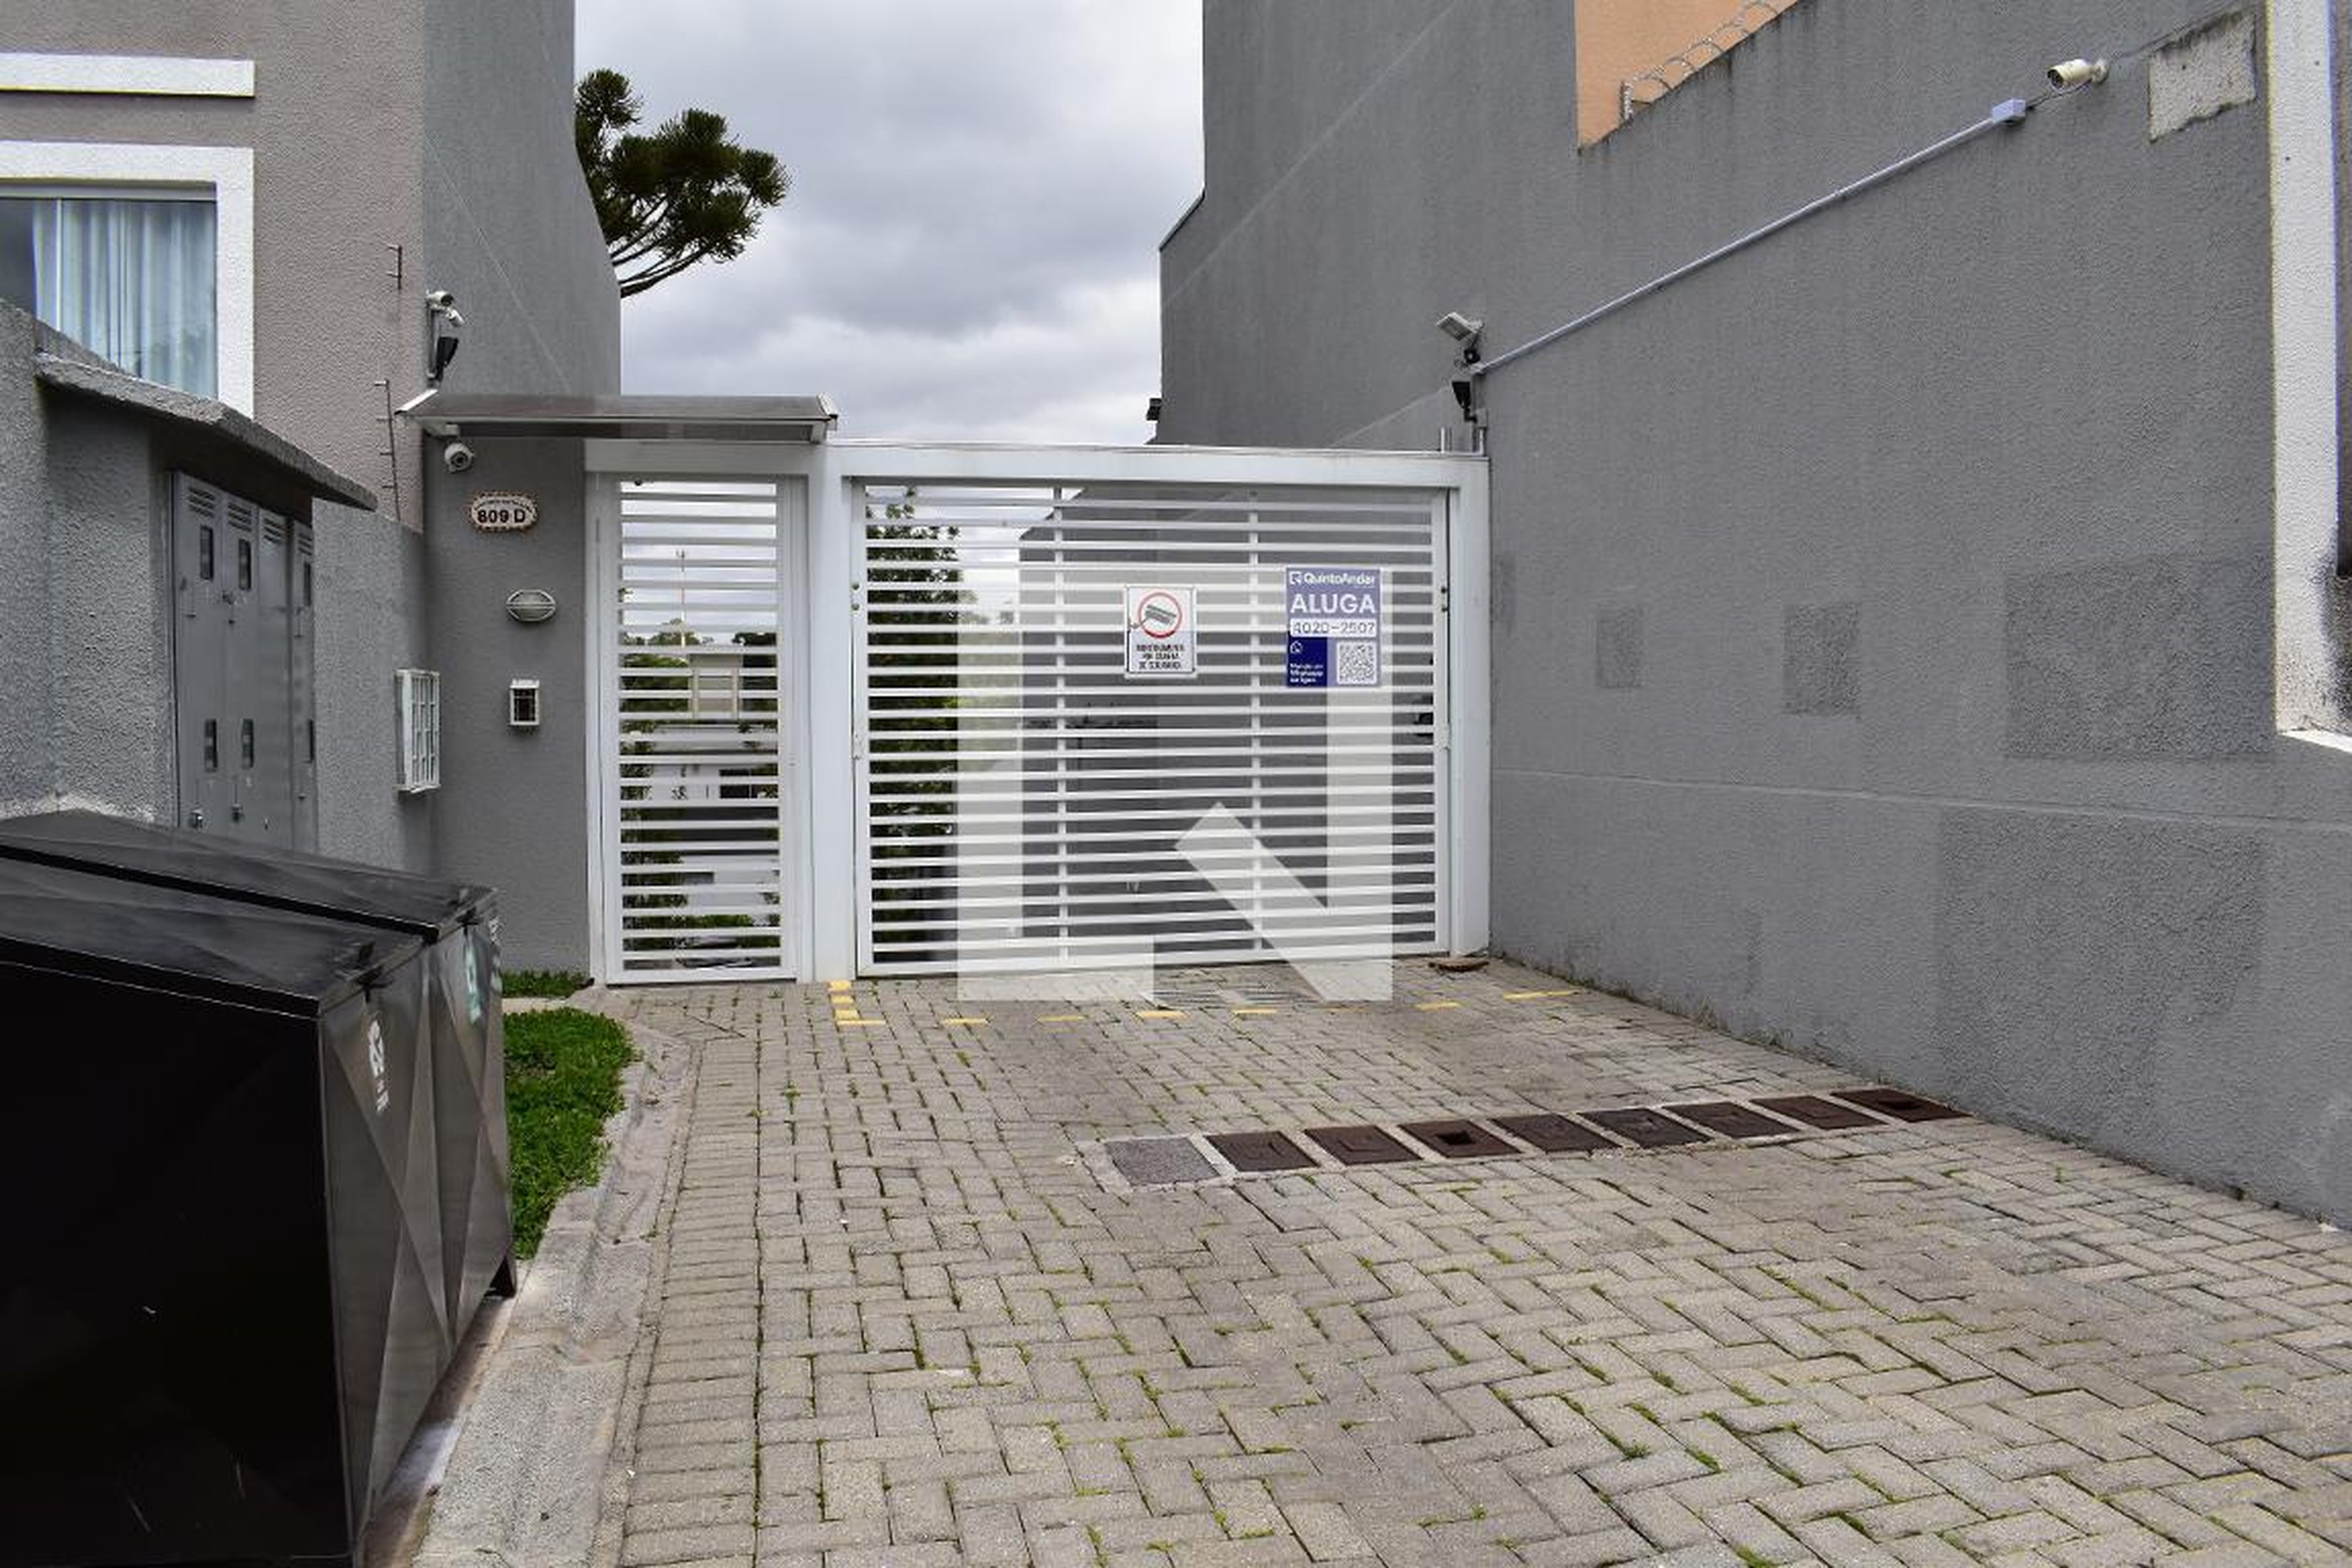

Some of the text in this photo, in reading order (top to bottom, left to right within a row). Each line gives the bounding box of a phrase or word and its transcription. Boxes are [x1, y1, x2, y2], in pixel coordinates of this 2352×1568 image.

[478, 509, 526, 523] 809 D
[1290, 594, 1376, 614] ALUGA
